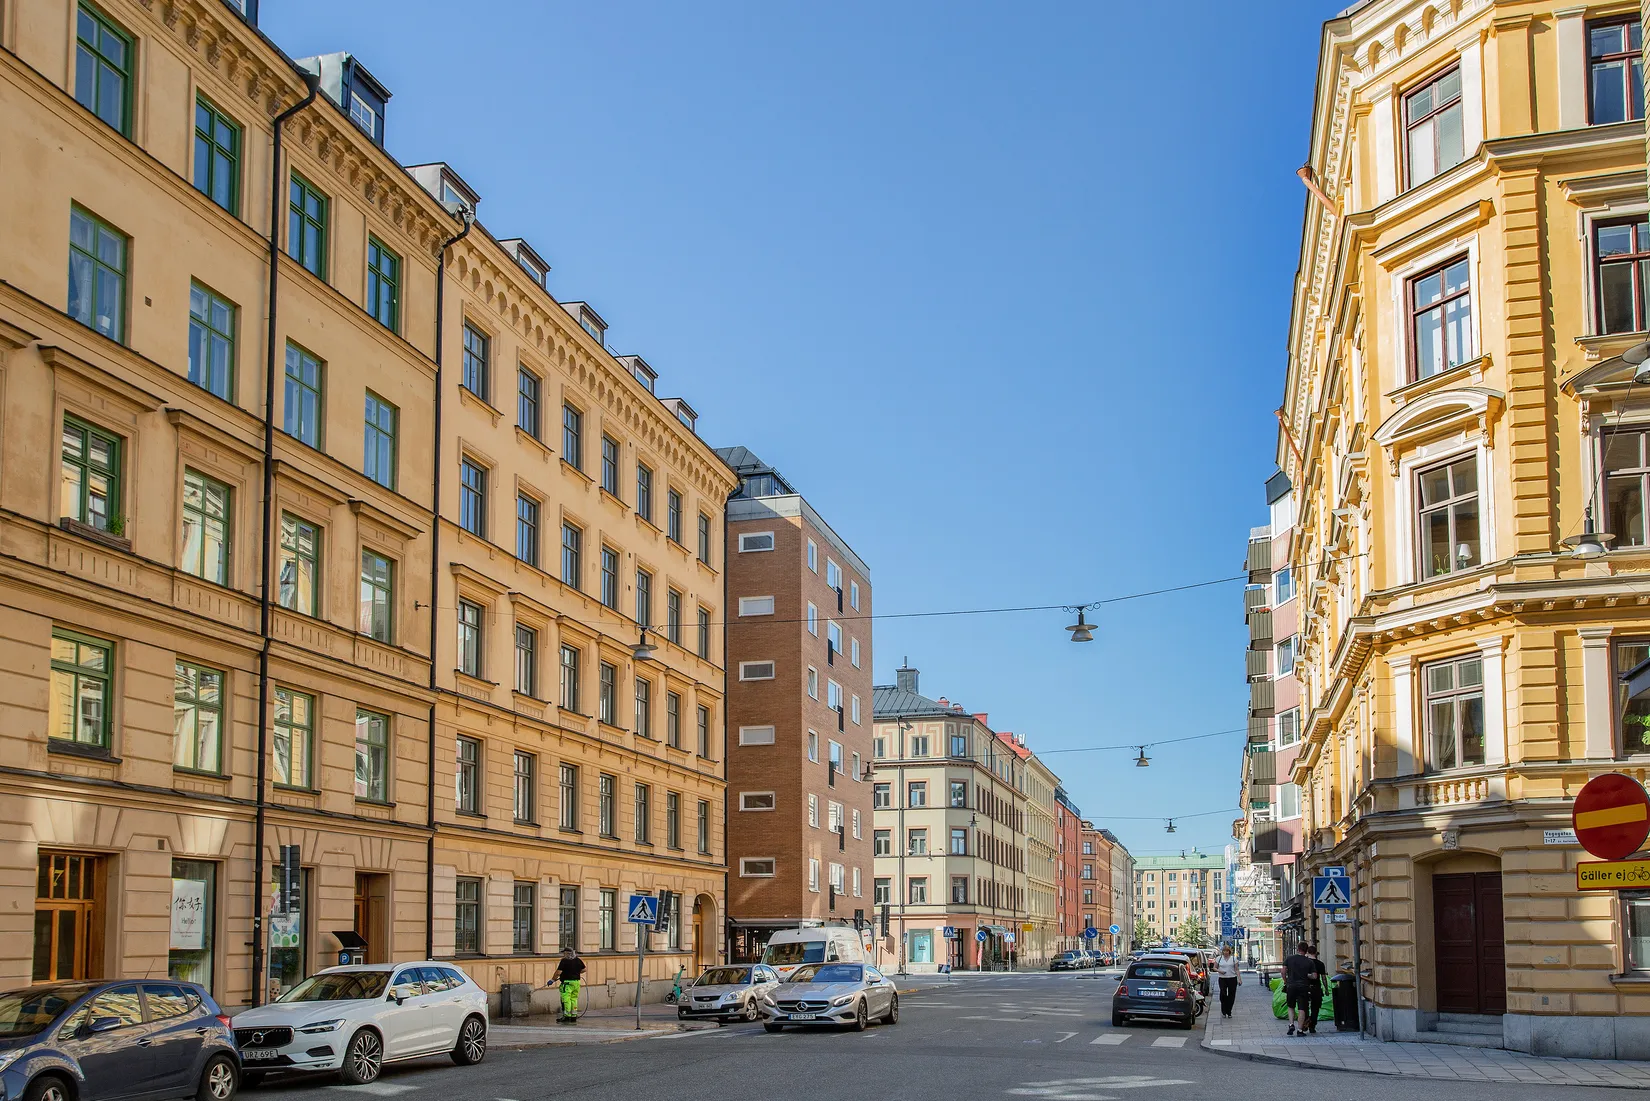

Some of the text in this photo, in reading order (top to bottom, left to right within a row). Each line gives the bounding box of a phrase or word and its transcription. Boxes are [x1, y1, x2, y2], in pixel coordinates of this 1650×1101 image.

[53, 869, 64, 887] 7
[1581, 869, 1626, 881] Gäller ej
[1224, 903, 1230, 911] P
